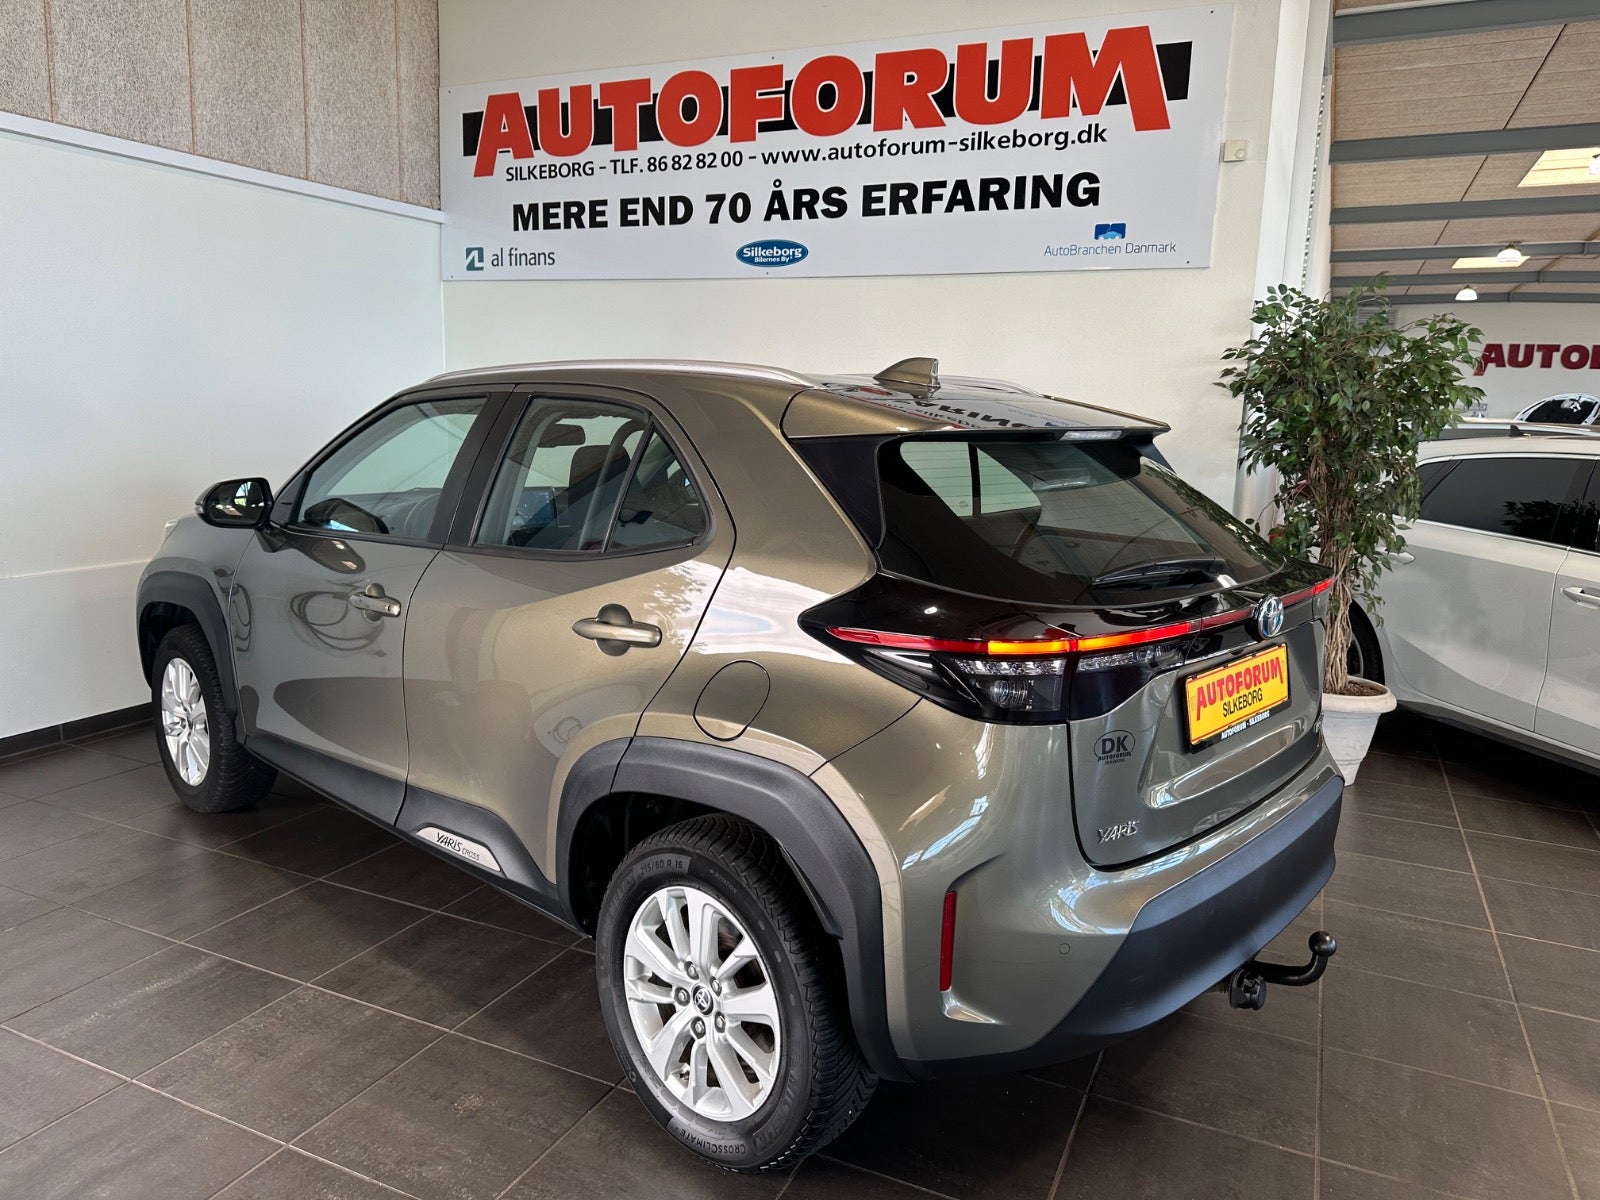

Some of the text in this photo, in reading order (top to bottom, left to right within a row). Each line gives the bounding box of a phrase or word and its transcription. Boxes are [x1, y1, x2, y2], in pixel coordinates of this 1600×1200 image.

[474, 26, 1171, 177] AUTOFORUM
[506, 161, 595, 182] SILKEBORG
[610, 157, 644, 175] TLF.
[647, 156, 668, 173] 86
[671, 154, 693, 171] 82
[695, 152, 718, 170] 82
[720, 150, 743, 168] 00
[760, 122, 1108, 165] www.autoforum-silkeborg.dk
[512, 171, 1101, 232] MERE END 70 ÅRS ERFARING
[491, 247, 556, 267] al finans
[743, 246, 803, 258] Silkeborg
[1043, 242, 1177, 257] AutoBranchen Danmark
[1196, 656, 1284, 721] AUTOFORUM
[1222, 688, 1263, 718] SILKEBORG
[1101, 735, 1128, 755] DK
